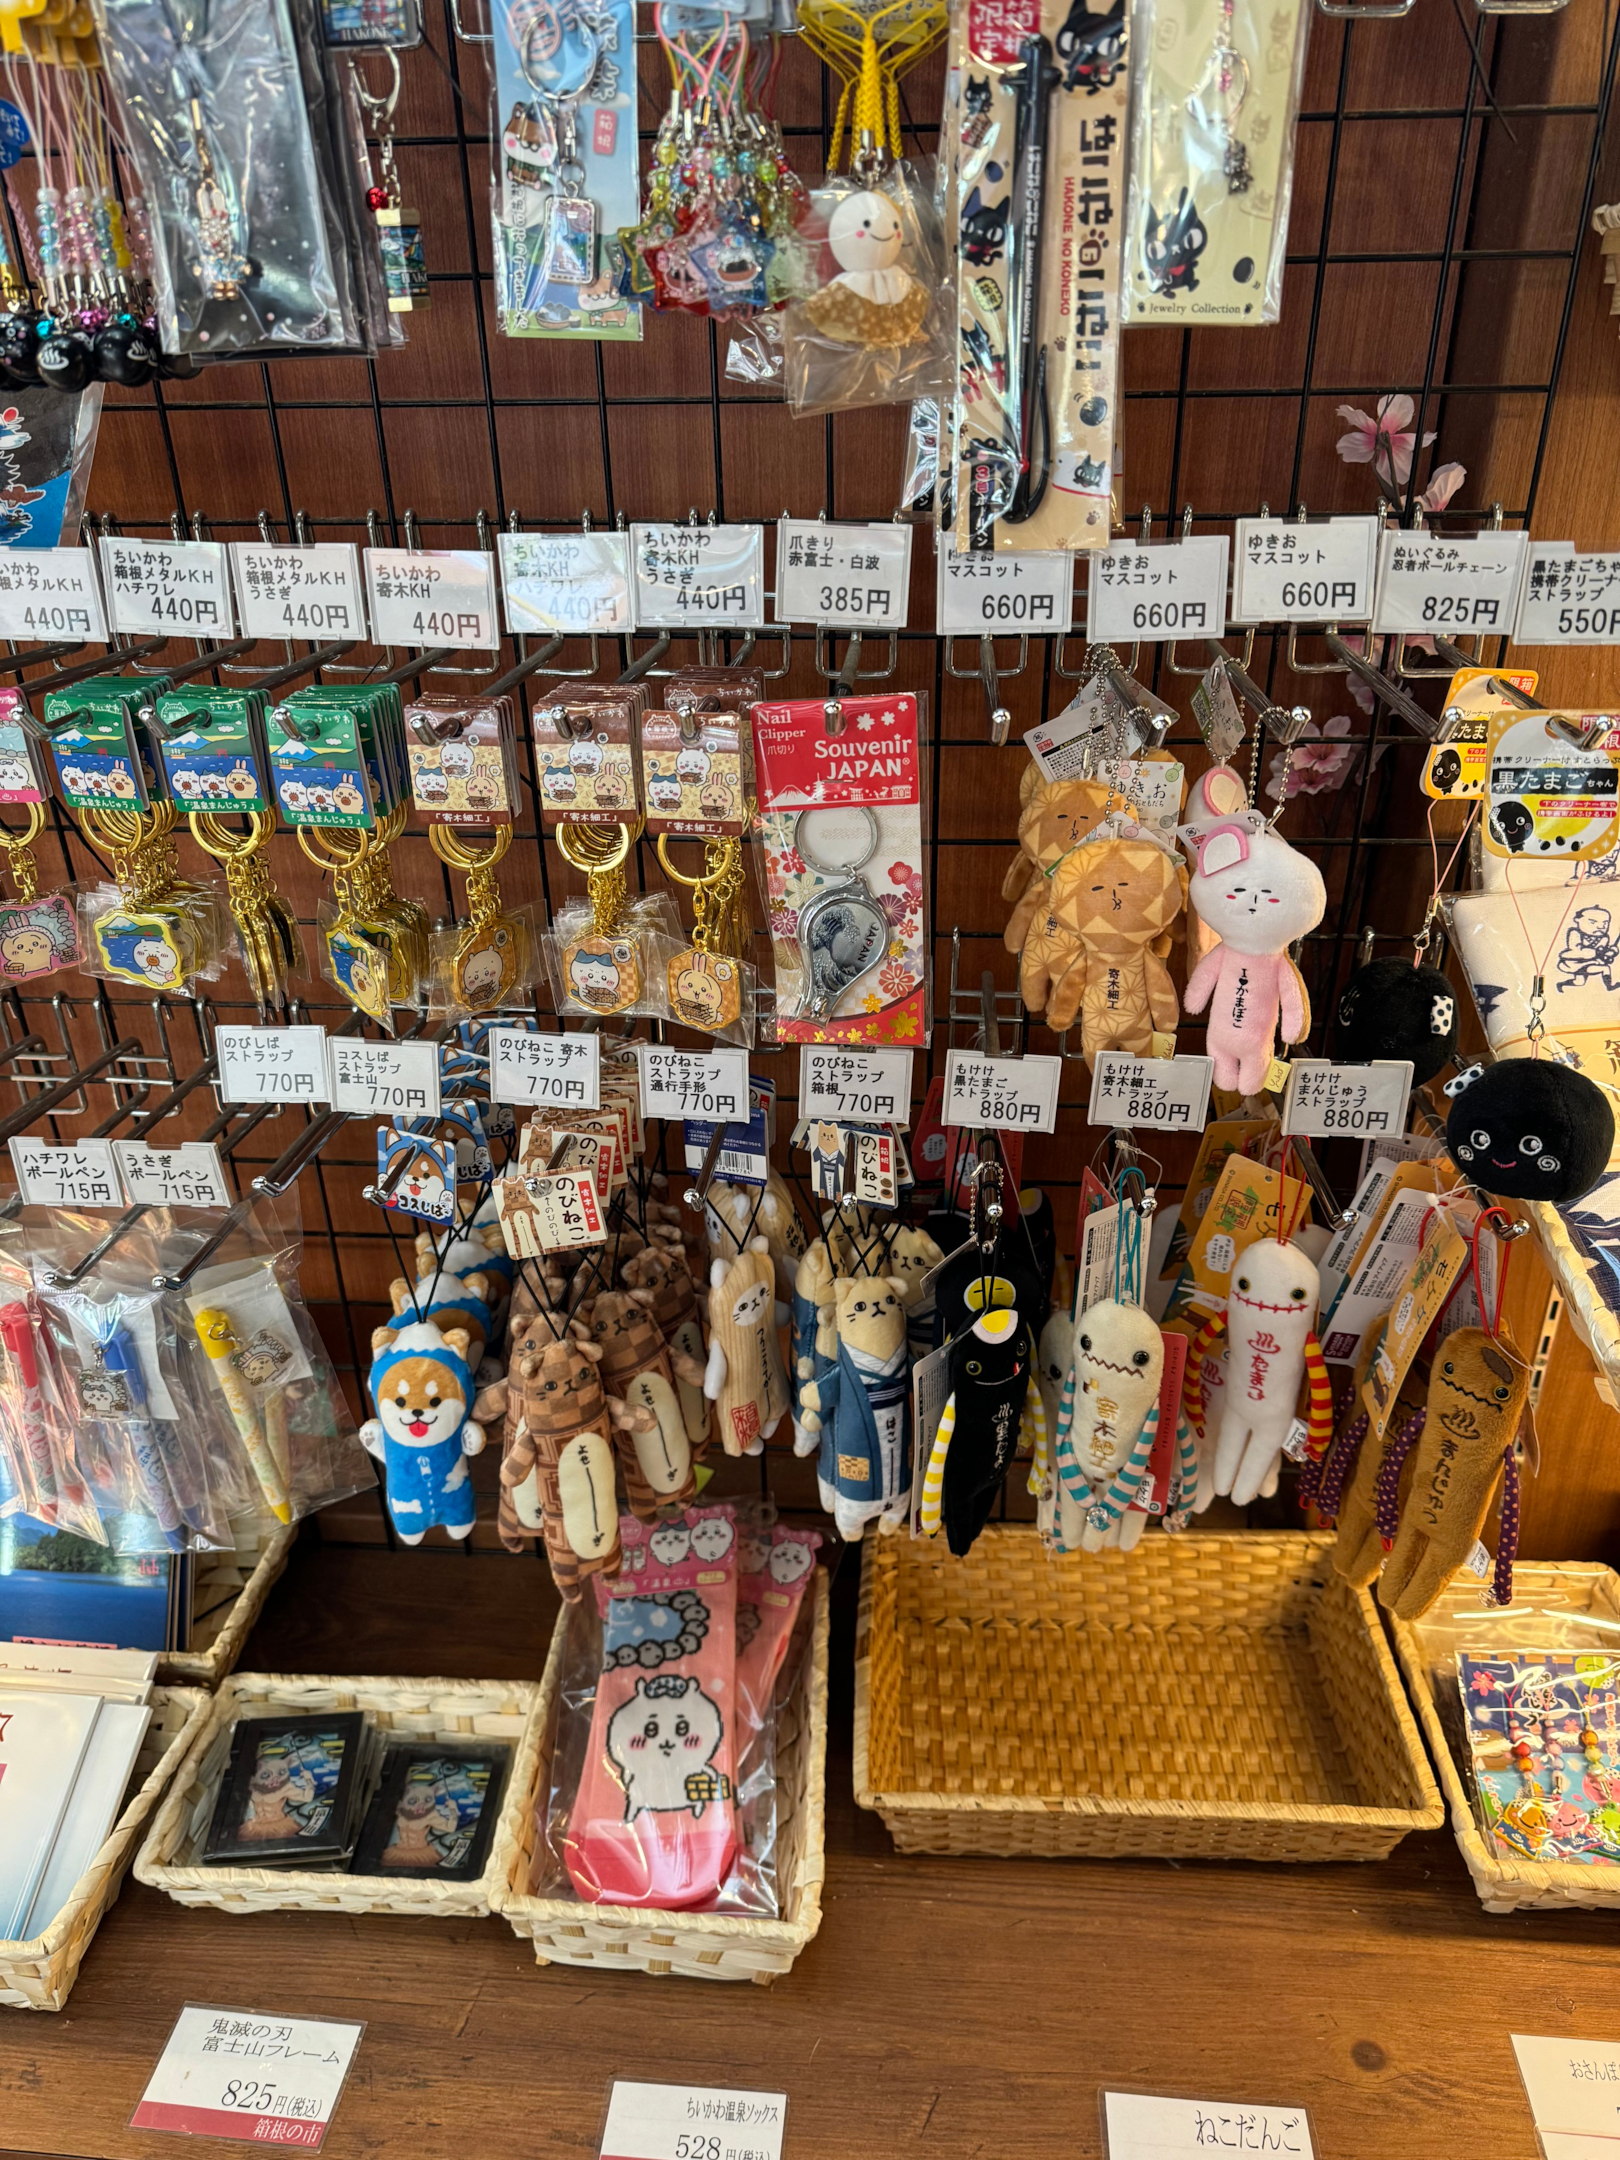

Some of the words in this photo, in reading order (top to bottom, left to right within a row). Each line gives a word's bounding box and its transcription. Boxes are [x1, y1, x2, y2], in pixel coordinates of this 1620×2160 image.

[1063, 176, 1075, 234] HAKONE
[1062, 238, 1073, 258] NO
[1060, 258, 1072, 317] KONEKO
[1149, 303, 1187, 315] Jewelry
[1191, 303, 1241, 314] Collection
[644, 530, 711, 548] ちいかわ
[789, 535, 835, 551] 爪きり
[1248, 533, 1297, 549] ゆきお
[114, 550, 172, 567] ちいかわ
[513, 542, 580, 561] ちいかわ
[643, 549, 700, 567] 寄木KH
[1248, 549, 1326, 564] マスコット
[1394, 546, 1460, 560] ぬいぐるみ
[245, 555, 303, 570] ちいかわ
[788, 551, 880, 571] 赤富士・白波
[1101, 555, 1150, 571] ゆきお
[1391, 559, 1508, 574] 忍者ボールチェーン
[114, 564, 214, 584] 箱根メタルKH
[246, 570, 346, 586] 箱根メタルKH
[376, 564, 441, 583] ちいかわ
[646, 567, 695, 585] うさぎ
[947, 564, 1023, 578] マスコット
[1101, 569, 1178, 586] マスコット
[117, 582, 175, 596] ハチワレ
[1529, 573, 1620, 589] 携帯クリーナ
[250, 585, 292, 601] うさぎ
[376, 582, 431, 599] 寄木KH
[676, 585, 746, 612] 440円
[1282, 581, 1356, 608] 660円
[1528, 587, 1605, 602] ストラップ
[549, 595, 617, 622] 440円
[820, 586, 891, 615] 385円
[981, 594, 1054, 620] 660円
[24, 606, 91, 632] 440円
[151, 597, 218, 624] 440円
[282, 603, 350, 629] 440円
[1132, 602, 1206, 629] 660円
[1422, 596, 1500, 625] 825円
[413, 611, 481, 638] 440円
[756, 710, 793, 726] Nail
[758, 729, 806, 741] Clipper
[1452, 723, 1488, 740] たま
[767, 744, 795, 755] 爪切り
[814, 736, 912, 759] Souvenir
[1107, 967, 1121, 1010] 寄木細工
[1231, 985, 1249, 1029] かまぼこ
[224, 1036, 280, 1050] のびしば
[500, 1037, 554, 1053] のびねこ
[560, 1044, 588, 1057] 寄木
[225, 1049, 294, 1063] ストラップ
[338, 1050, 390, 1063] コスしば
[500, 1051, 571, 1068] ストラップ
[649, 1054, 705, 1068] のびねこ
[812, 1056, 869, 1070] のびねこ
[338, 1062, 402, 1075] ストラップ
[650, 1067, 722, 1081] ストラップ
[811, 1070, 885, 1083] ストラップ
[955, 1063, 995, 1076] もけけ
[1104, 1063, 1146, 1077] もけけ
[256, 1073, 314, 1093] 770円
[338, 1073, 378, 1086] 富士山
[649, 1079, 707, 1093] 通行手形
[953, 1075, 1008, 1089] 黒たまご
[1102, 1075, 1158, 1089] 寄木細工
[1300, 1072, 1343, 1084] もけけ
[527, 1075, 585, 1100] 770円
[811, 1082, 839, 1095] 箱根
[953, 1087, 1019, 1102] ストラップ
[1101, 1087, 1169, 1101] ストラップ
[1298, 1083, 1368, 1097] まんじゅう
[367, 1086, 426, 1108] 770円
[677, 1092, 736, 1114] 770円
[836, 1092, 895, 1114] 770円
[1296, 1096, 1367, 1109] ストラップ
[980, 1100, 1041, 1124] 880円
[1127, 1100, 1191, 1123] 880円
[1323, 1109, 1389, 1131] 880円
[23, 1152, 88, 1165] ハチワレ
[126, 1154, 172, 1168] うさぎ
[860, 1135, 878, 1199] のびねこ
[26, 1165, 106, 1180] ボールペン
[129, 1167, 209, 1182] ボールペン
[55, 1182, 111, 1201] 715円
[158, 1184, 216, 1202] 715円
[398, 1194, 451, 1217] コスしば
[555, 1177, 585, 1241] のびねこ
[207, 2018, 294, 2042] 鬼滅の刃
[201, 2035, 341, 2064] 富士山フレーム
[687, 2096, 779, 2125] ちいかわ温泉ソックス
[253, 2117, 322, 2144] 箱根の市
[1194, 2109, 1302, 2152] ねこだんご
